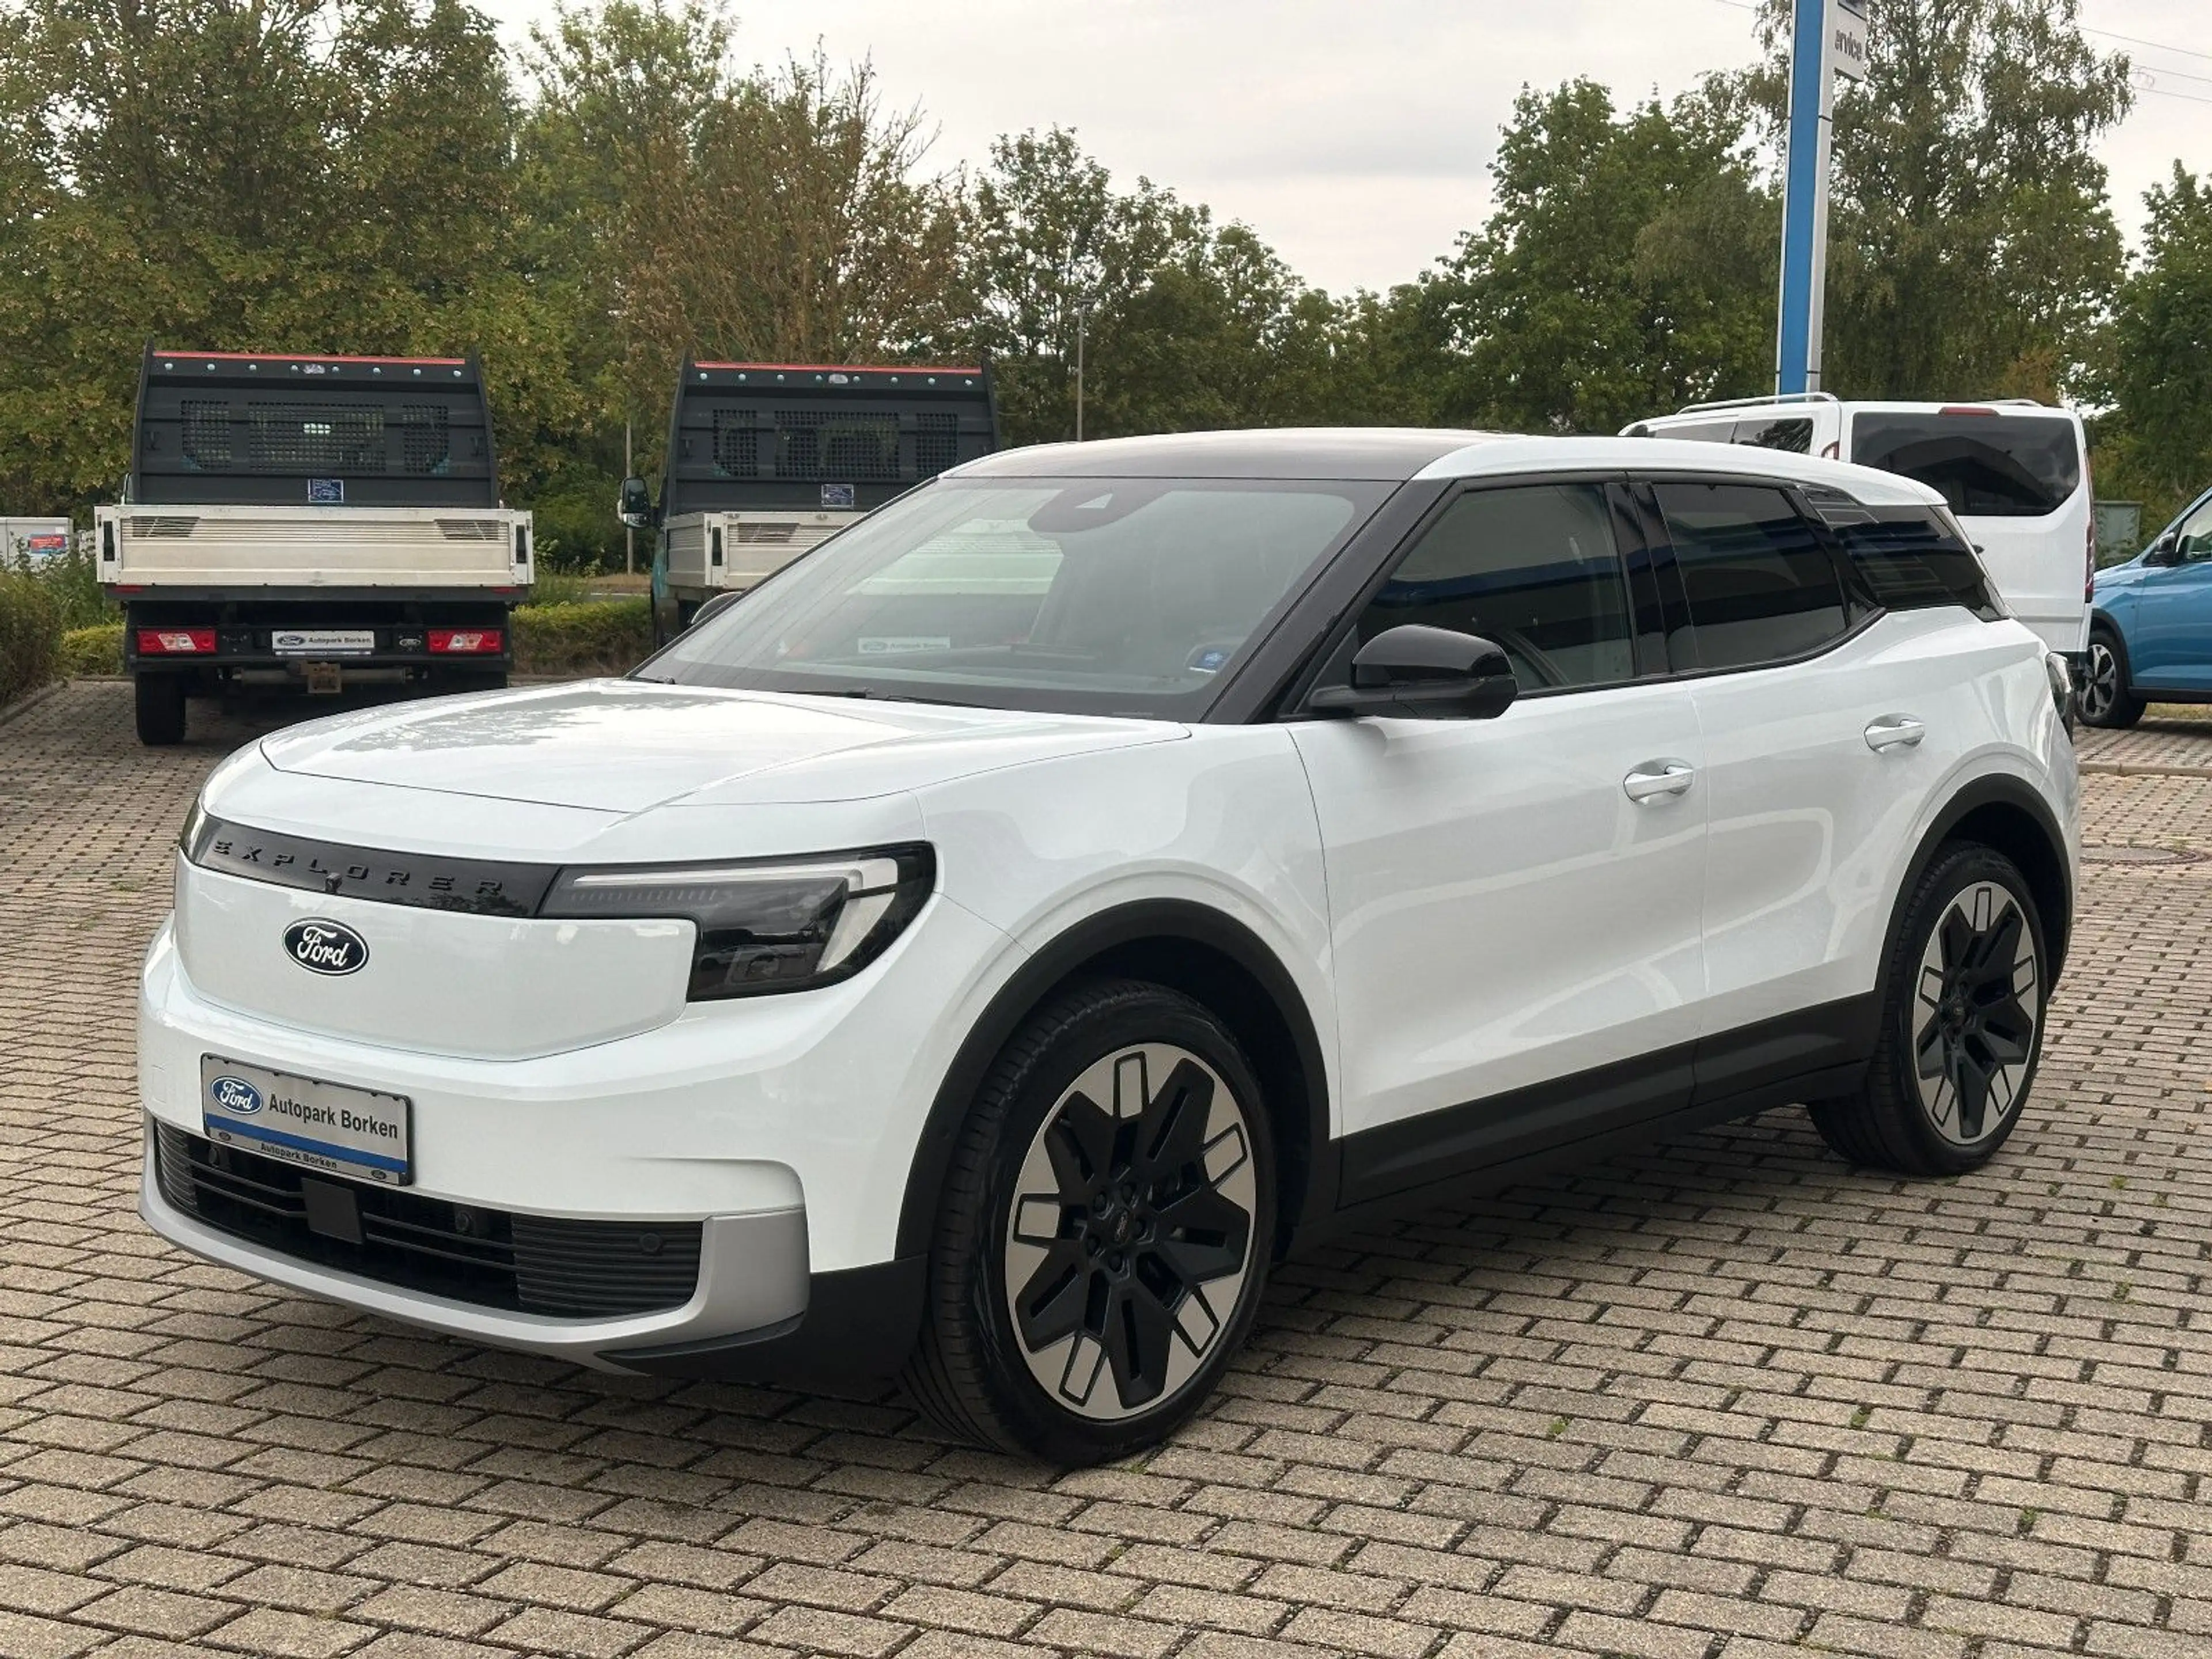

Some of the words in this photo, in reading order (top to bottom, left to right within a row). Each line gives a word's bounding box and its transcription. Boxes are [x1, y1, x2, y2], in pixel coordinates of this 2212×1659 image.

[213, 840, 503, 896] EXPLORER
[297, 926, 351, 967] Ford
[219, 1081, 253, 1109] Ford
[269, 1093, 336, 1126] Autopark
[341, 1109, 398, 1139] Borken
[261, 1142, 301, 1160] Autopark
[303, 1153, 338, 1169] Borken
